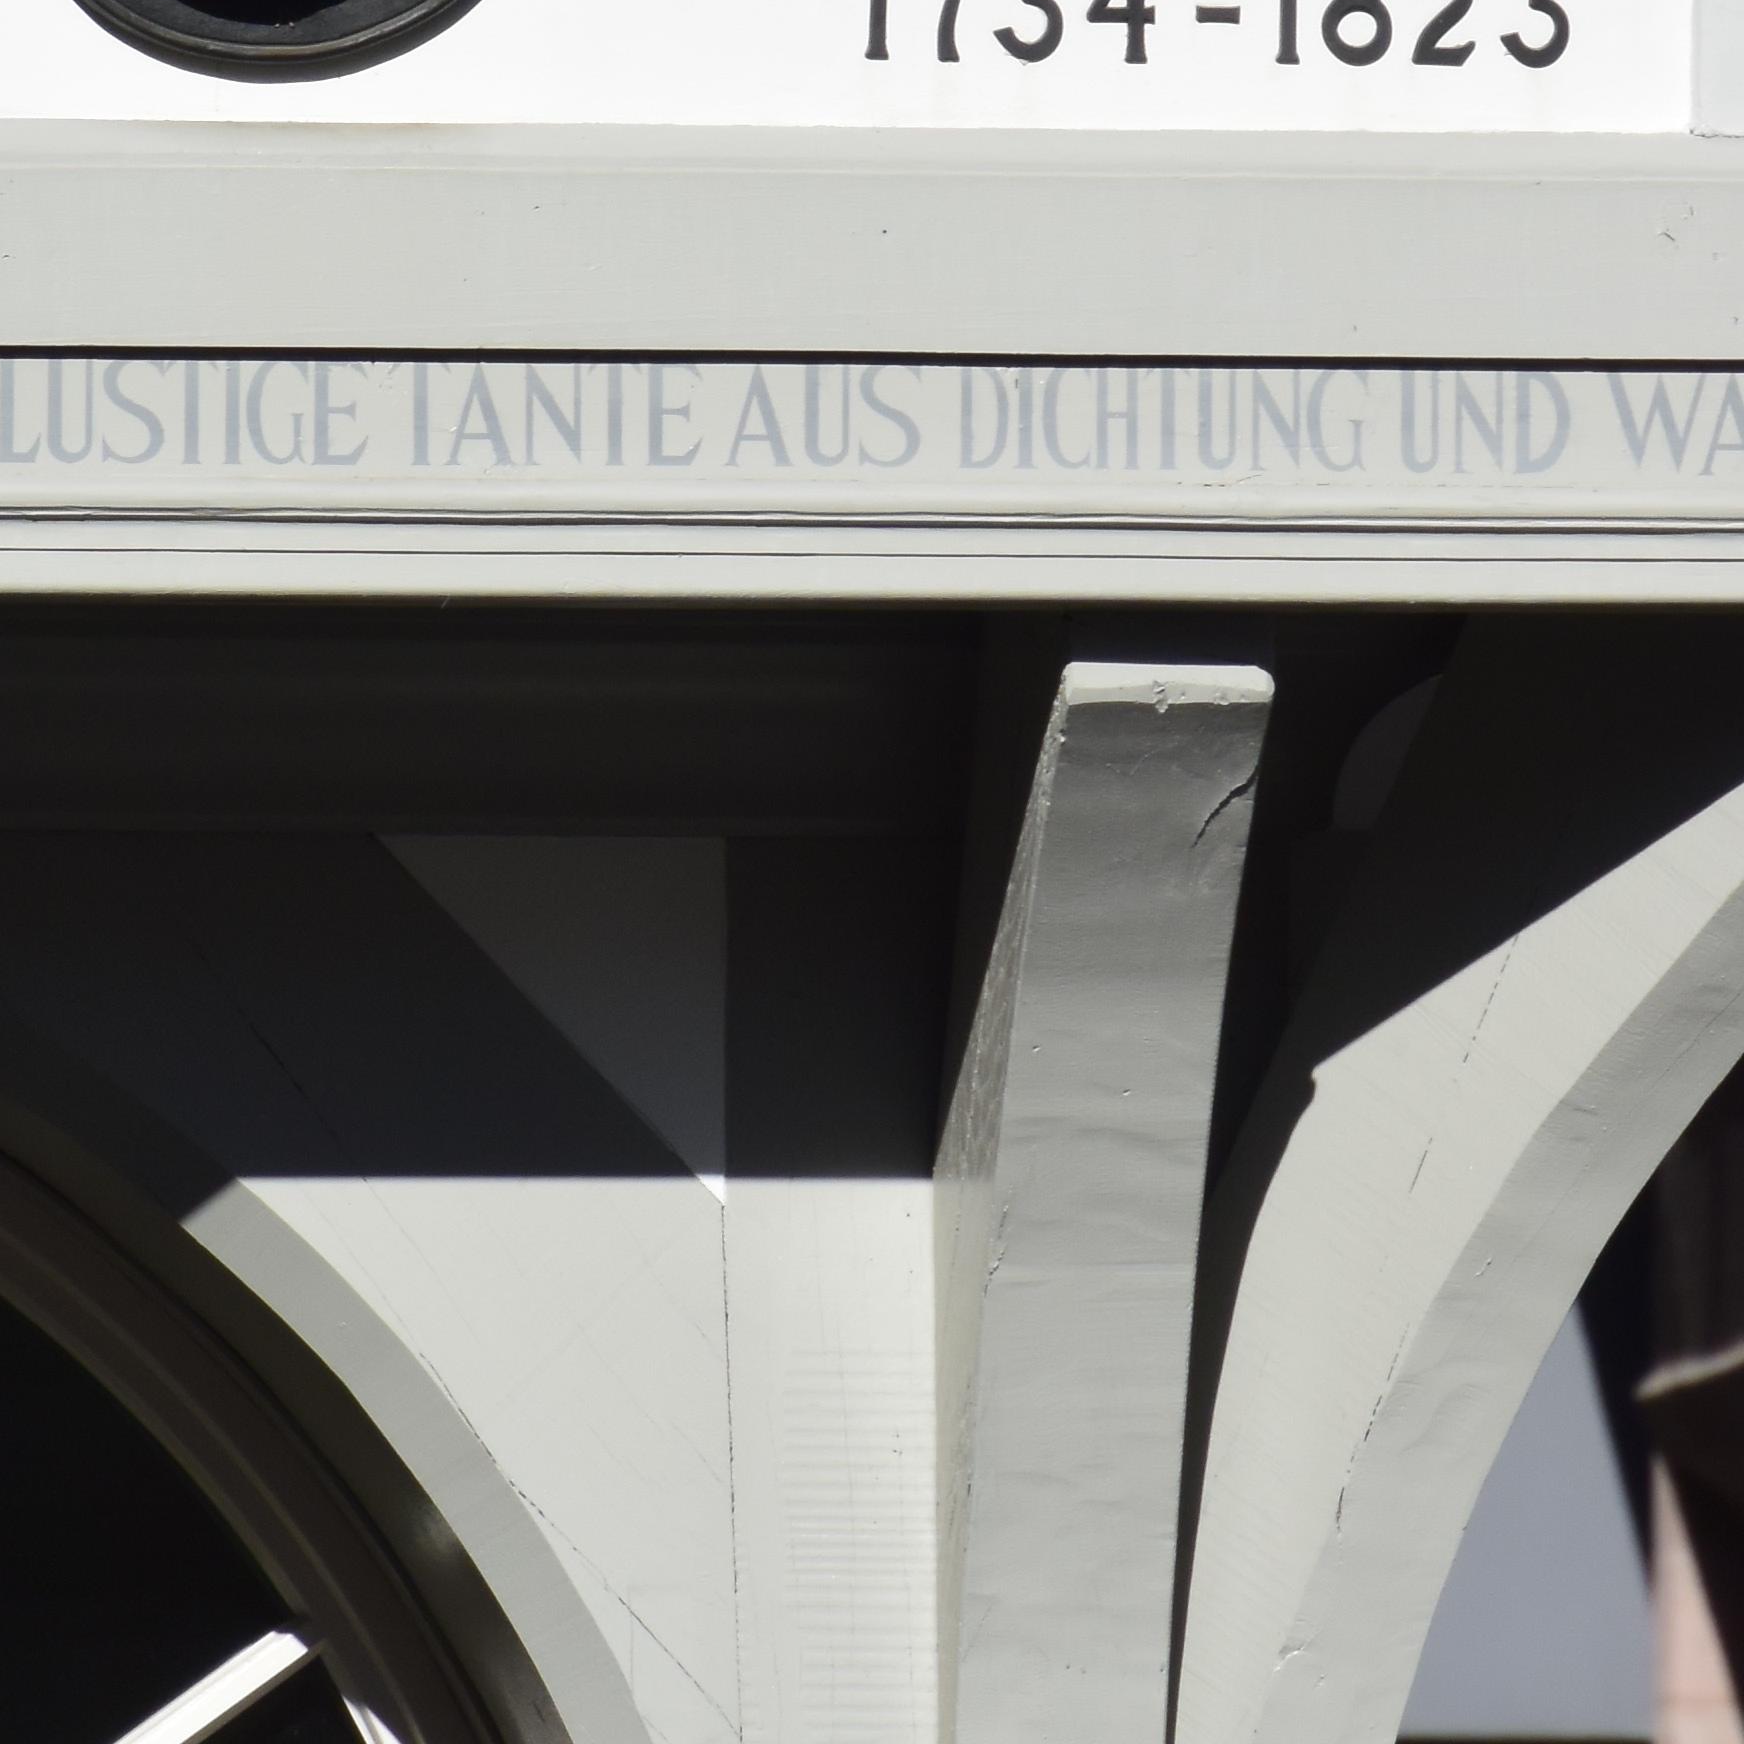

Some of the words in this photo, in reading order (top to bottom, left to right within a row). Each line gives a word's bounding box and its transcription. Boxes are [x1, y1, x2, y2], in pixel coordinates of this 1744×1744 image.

[389, 362, 703, 467] TANTE
[725, 364, 922, 468] AUS
[958, 366, 1365, 472] DICHTUNG
[1399, 370, 1571, 474] UND
